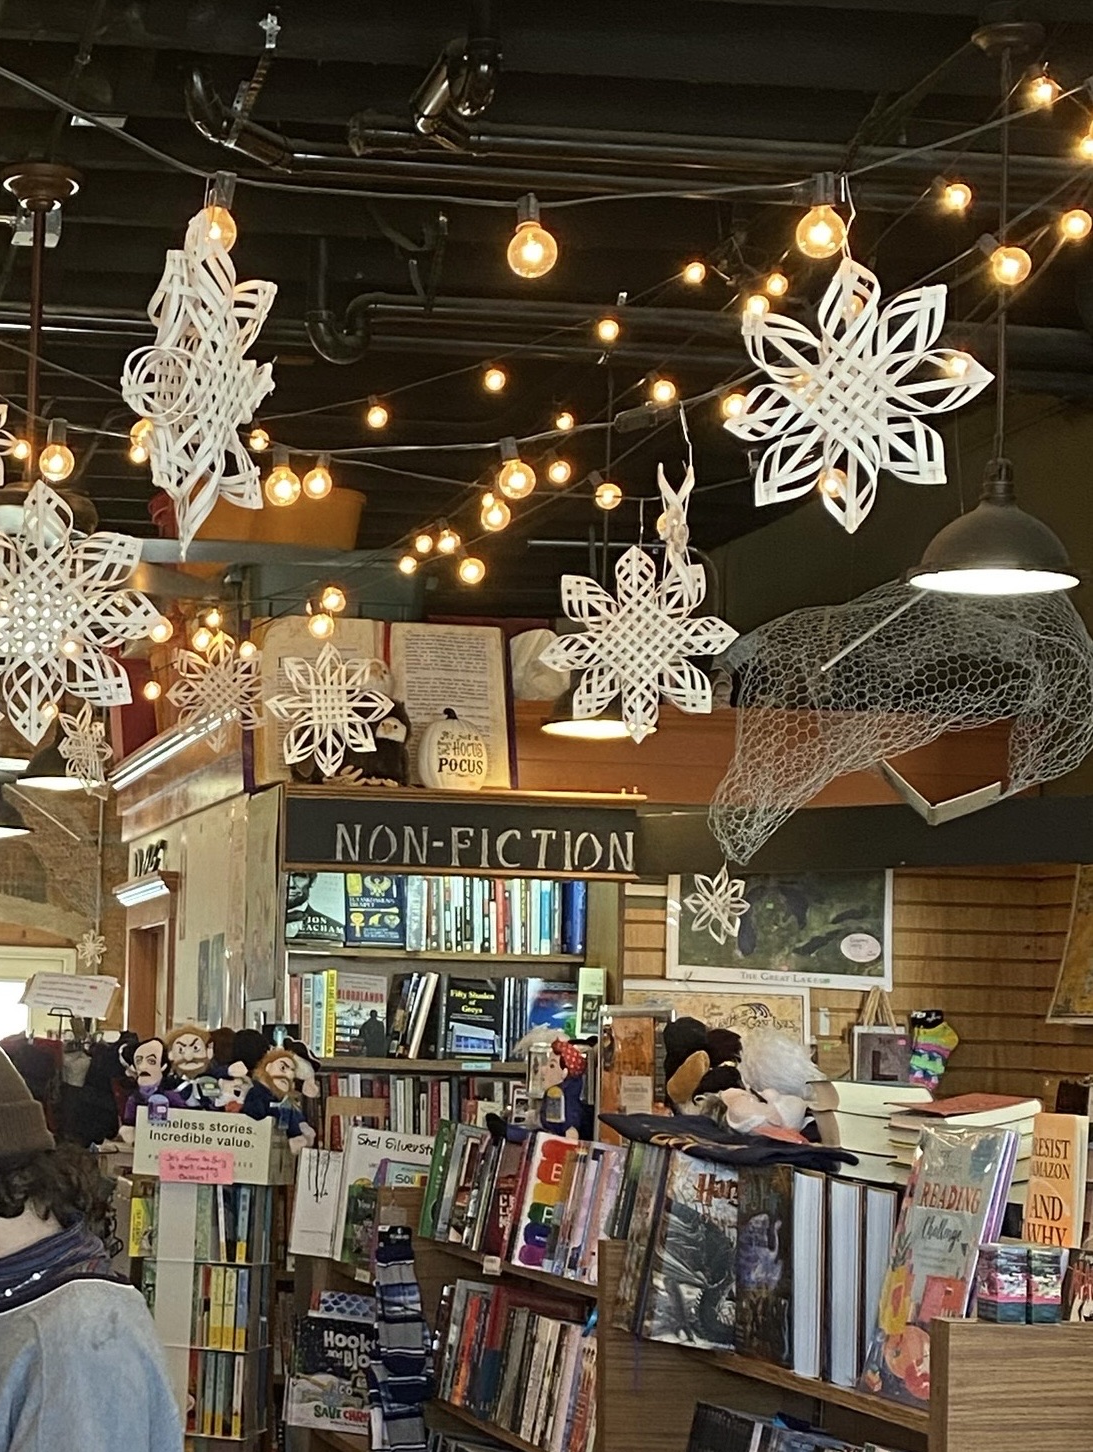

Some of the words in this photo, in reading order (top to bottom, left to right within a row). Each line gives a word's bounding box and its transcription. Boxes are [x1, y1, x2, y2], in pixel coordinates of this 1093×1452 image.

[453, 741, 484, 758] HOCUS
[438, 758, 484, 775] POCUS
[335, 822, 635, 873] NON-FICTION
[307, 916, 327, 924] JON
[151, 1118, 205, 1131] meless
[209, 1122, 257, 1136] stories.
[149, 1130, 213, 1146] Incredible
[216, 1136, 255, 1149] value.
[357, 1133, 381, 1150] Shel
[920, 1181, 982, 1215] READING
[1029, 1193, 1064, 1222] AND
[921, 1215, 962, 1254] Challenge
[1027, 1222, 1068, 1248] WHY
[314, 1404, 342, 1420] SAVE
